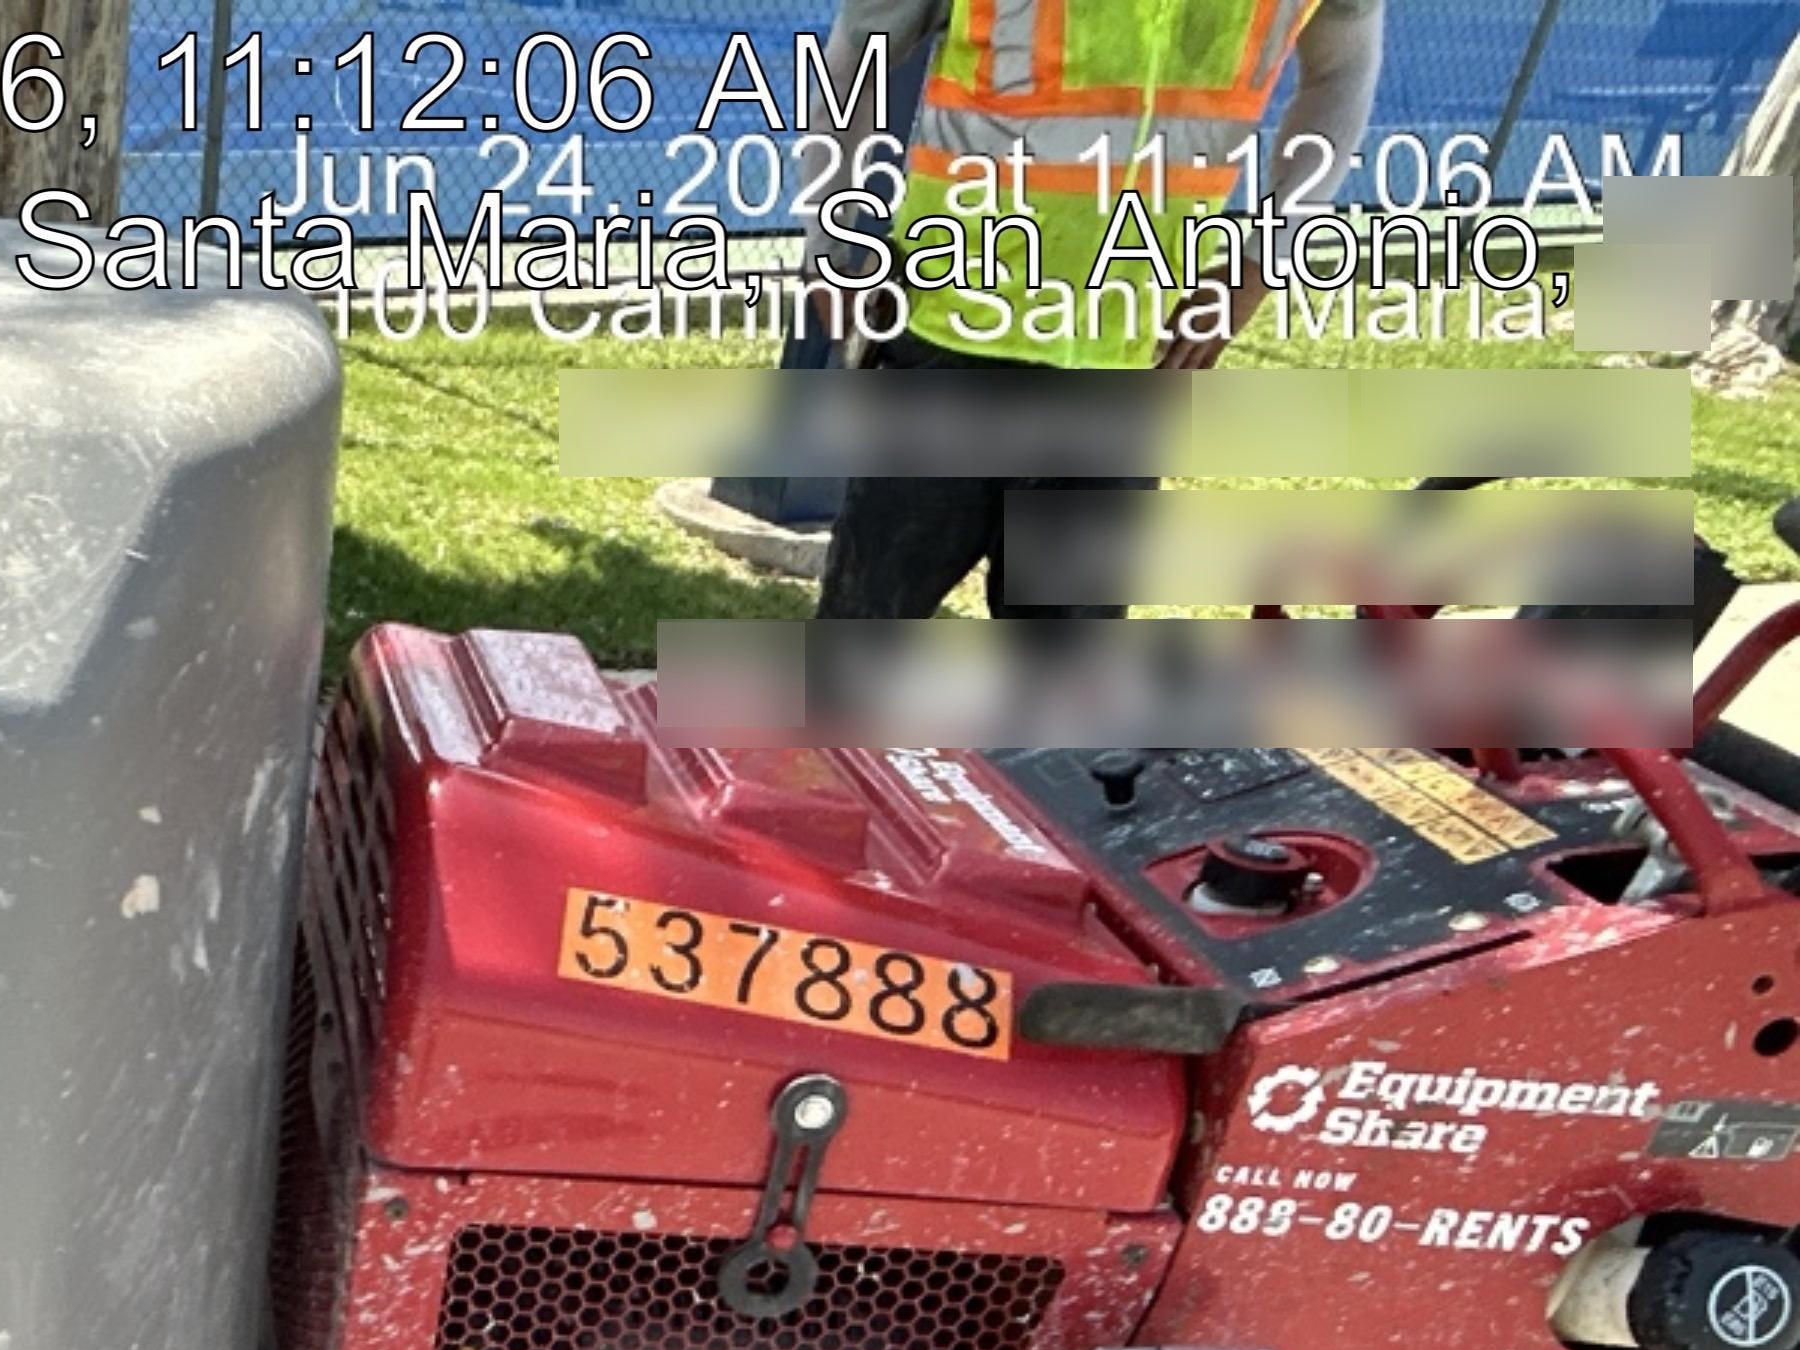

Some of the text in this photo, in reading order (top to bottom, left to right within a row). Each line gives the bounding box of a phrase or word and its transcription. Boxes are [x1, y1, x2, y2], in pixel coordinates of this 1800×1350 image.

[574, 893, 999, 1050] 537888
[1337, 1061, 1662, 1118] Equipment
[1318, 1105, 1488, 1154] Share
[1215, 1165, 1359, 1192] CALL NOW
